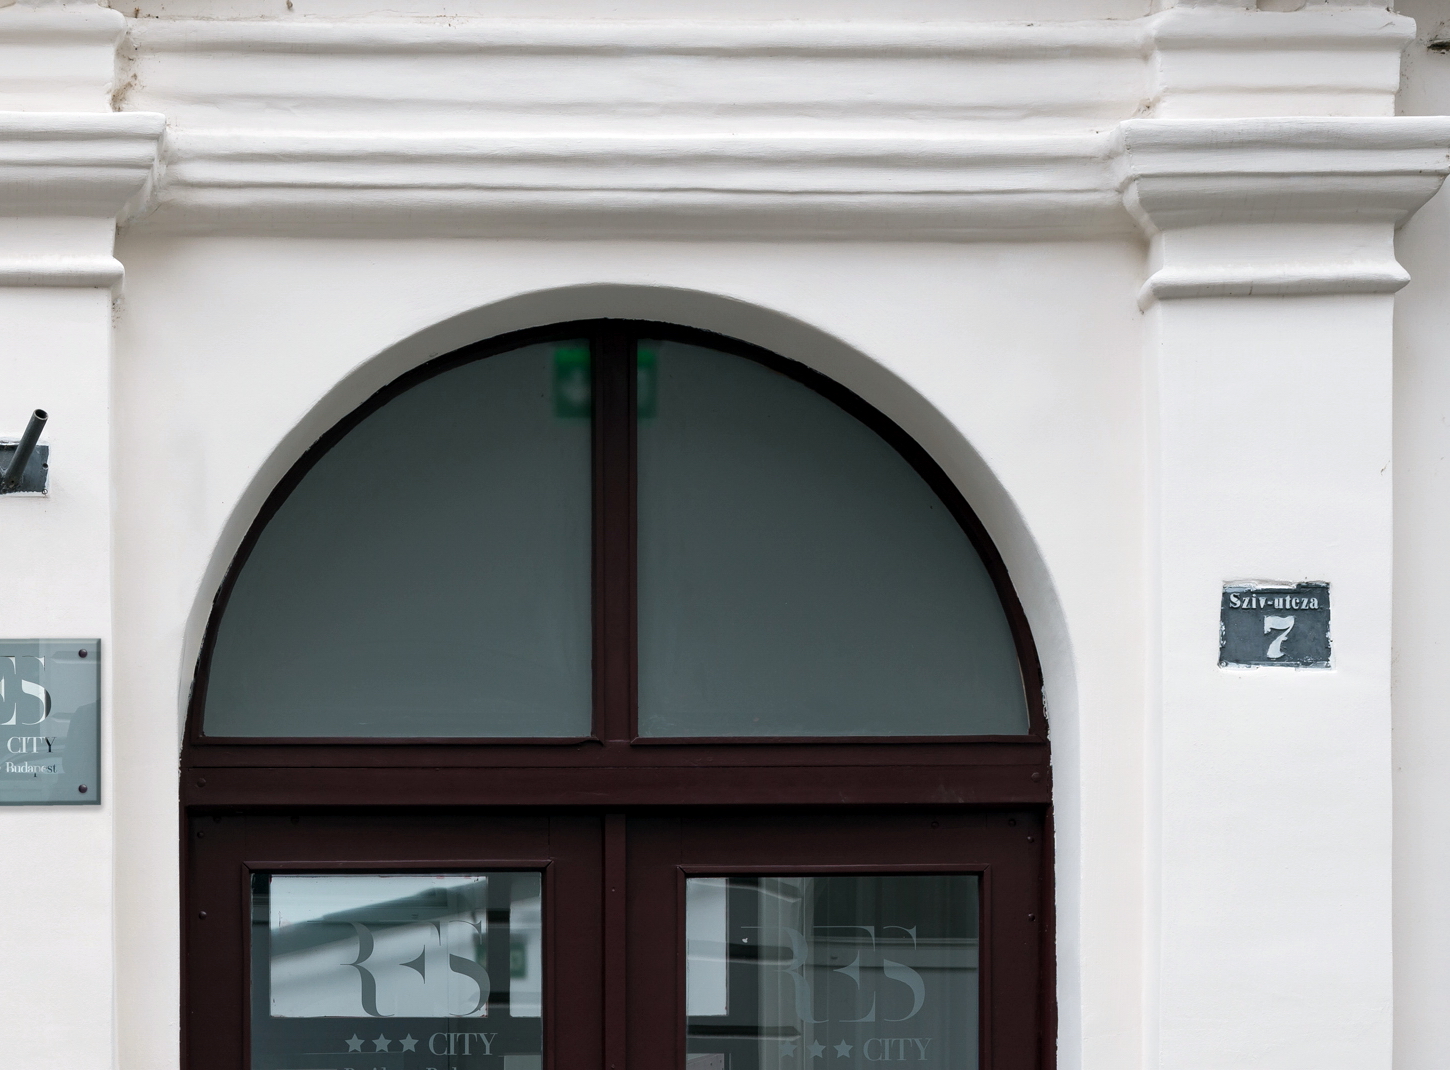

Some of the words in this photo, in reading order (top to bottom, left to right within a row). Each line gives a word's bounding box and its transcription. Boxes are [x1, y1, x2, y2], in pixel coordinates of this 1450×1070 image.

[1230, 592, 1319, 609] Sziv-utcza
[1263, 615, 1295, 659] 7
[6, 736, 57, 754] CITY
[5, 762, 58, 778] Budapest
[307, 920, 491, 1018] RES
[740, 925, 926, 1024] RES
[428, 1032, 498, 1056] CITY
[863, 1037, 933, 1061] CITY
